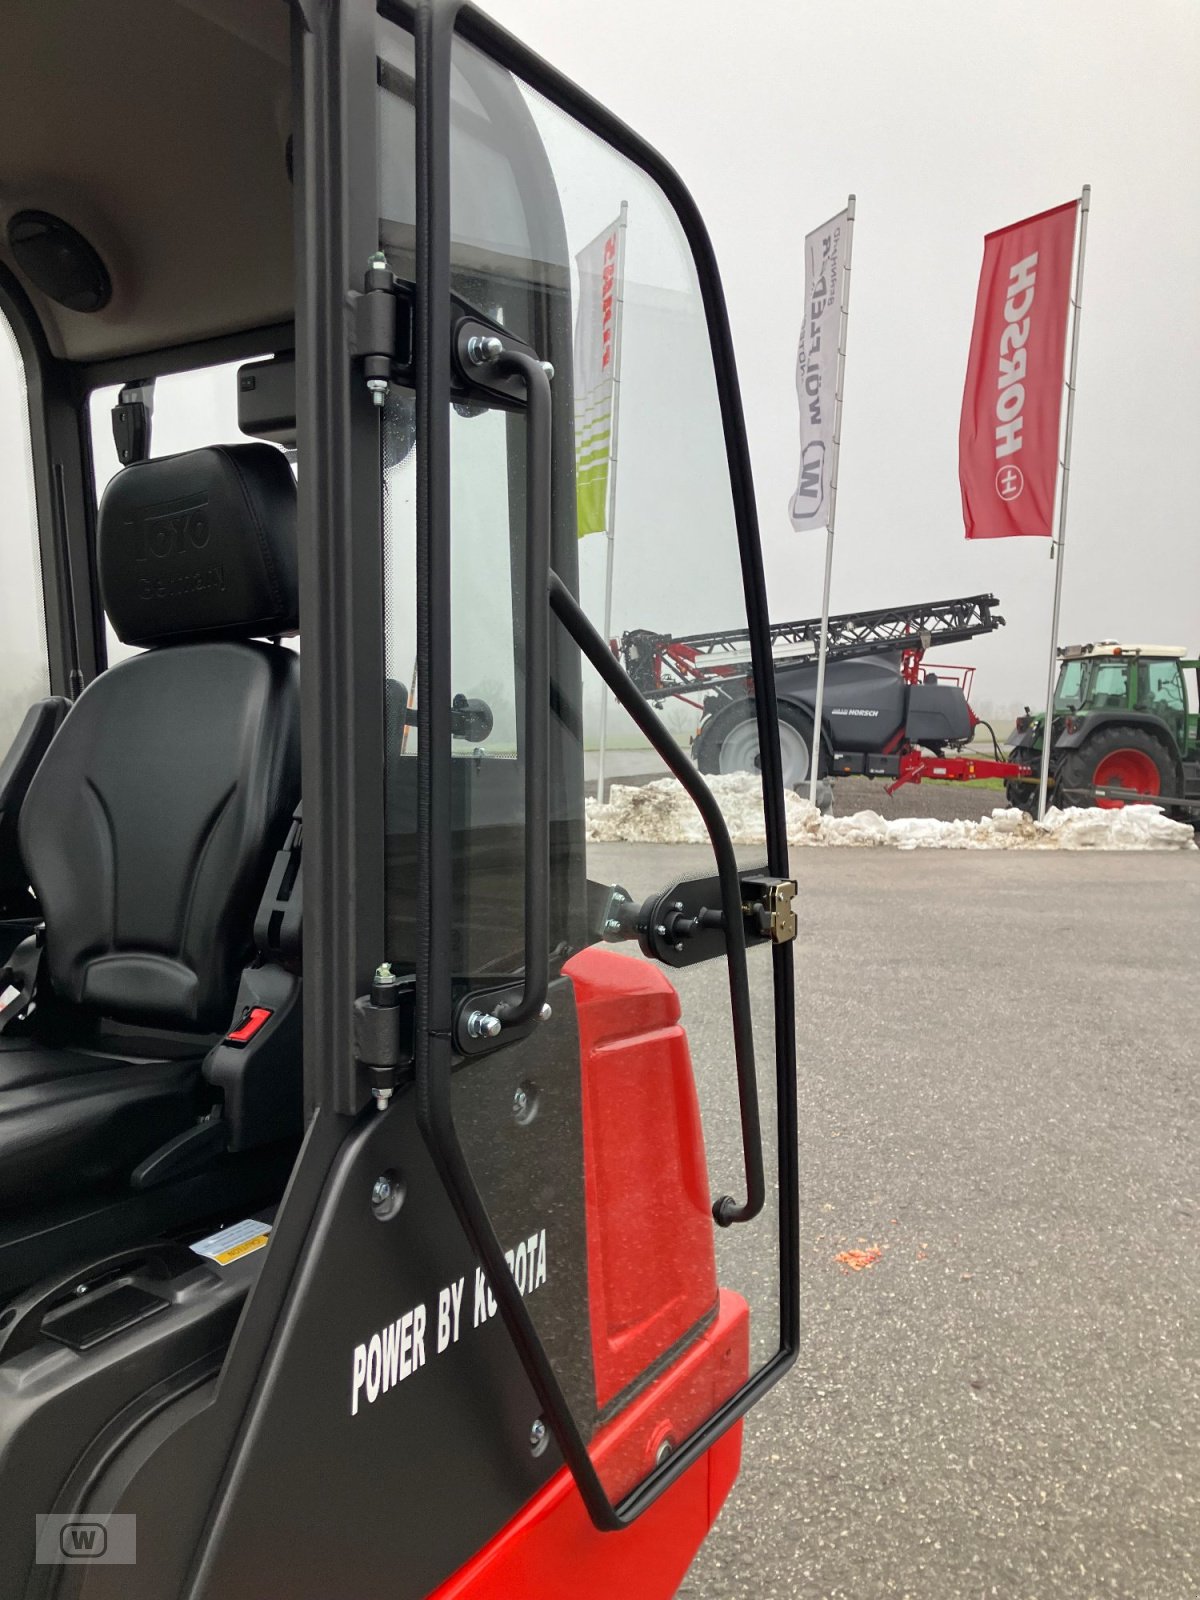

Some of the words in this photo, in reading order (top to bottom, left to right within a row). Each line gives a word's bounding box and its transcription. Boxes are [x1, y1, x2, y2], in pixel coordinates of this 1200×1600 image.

[849, 709, 879, 717] HORSCH
[352, 1303, 427, 1416] POWER
[437, 1276, 465, 1354] BY
